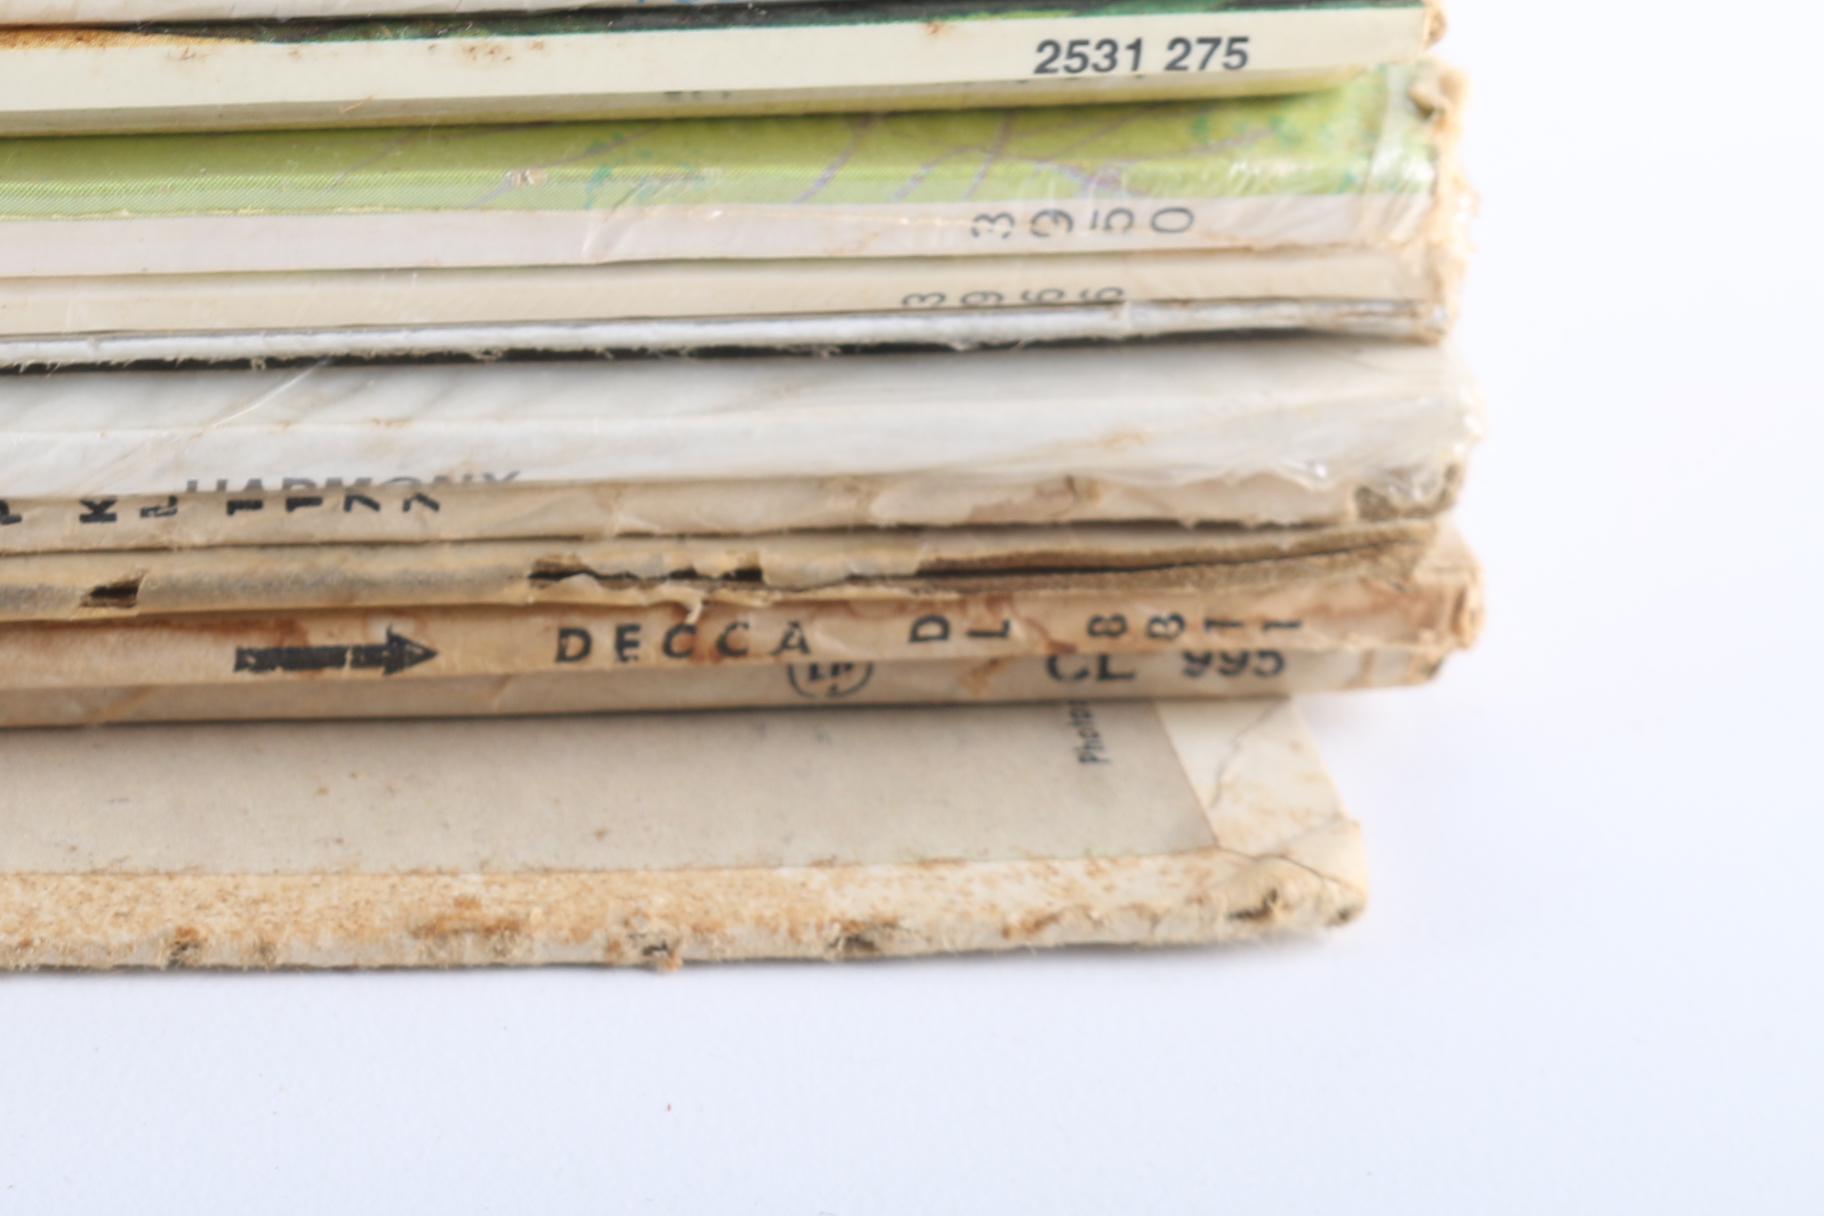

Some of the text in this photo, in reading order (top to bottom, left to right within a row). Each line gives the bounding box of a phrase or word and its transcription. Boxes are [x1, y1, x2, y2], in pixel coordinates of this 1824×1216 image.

[1033, 36, 1251, 75] 2531 275
[553, 618, 813, 664] DECCA
[908, 613, 1012, 643] DL
